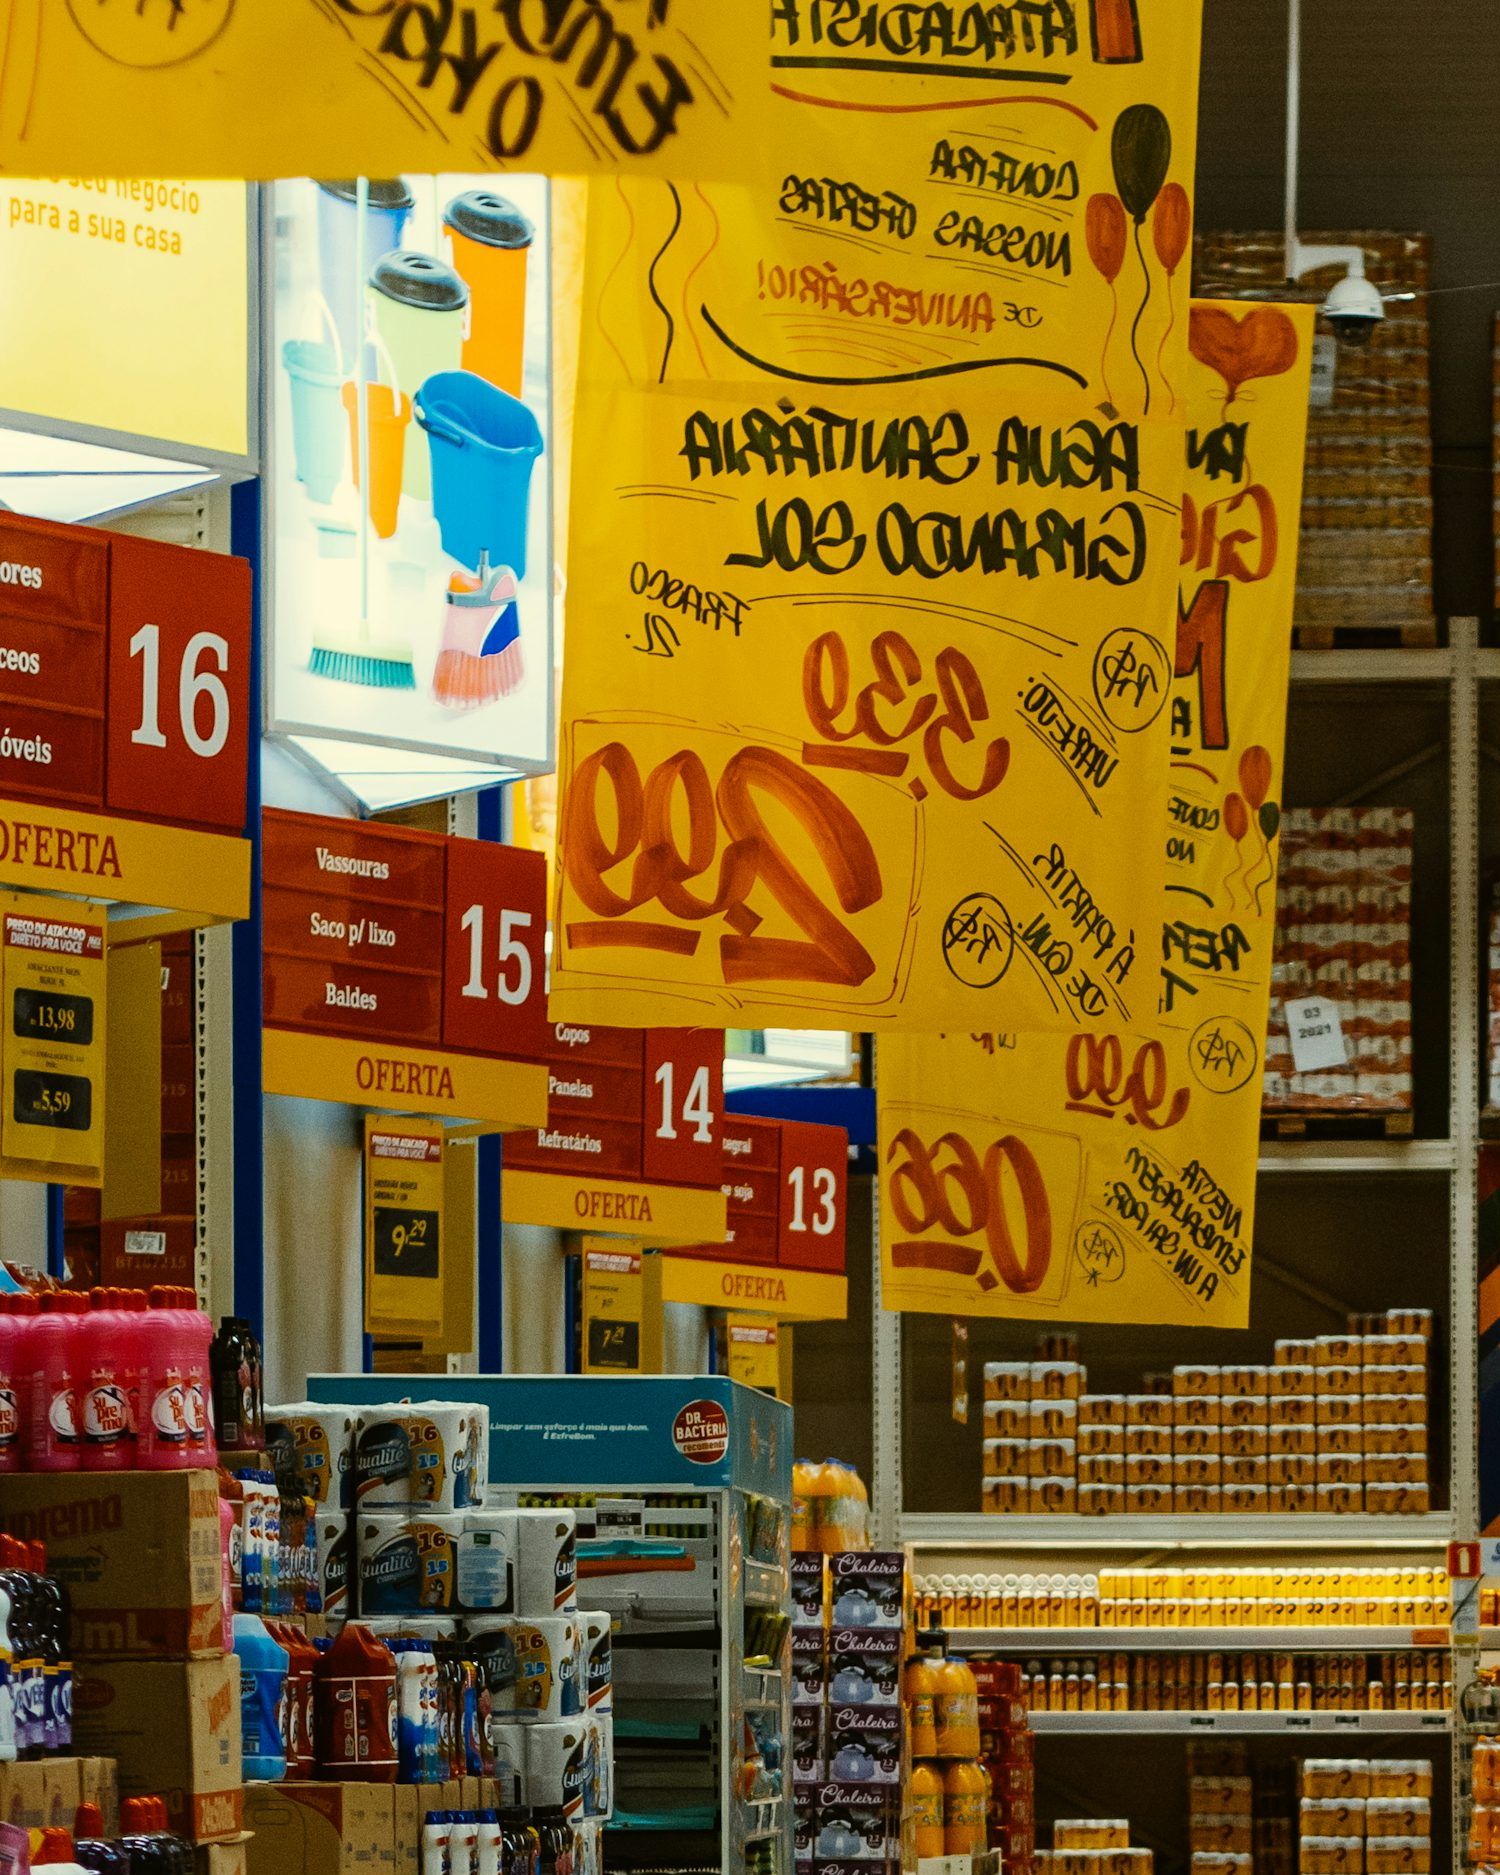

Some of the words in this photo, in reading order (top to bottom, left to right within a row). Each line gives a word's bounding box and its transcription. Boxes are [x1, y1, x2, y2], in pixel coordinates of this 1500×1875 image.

[9, 197, 60, 229] para
[68, 209, 80, 234] a
[88, 213, 126, 243] sua
[133, 223, 182, 256] casa
[129, 623, 231, 758] 16
[0, 817, 123, 879] OFERTA
[315, 847, 389, 879] Vassouras
[310, 911, 344, 938] Saco
[348, 919, 365, 947] p/
[369, 922, 396, 947] lixo
[460, 904, 532, 1006] 15
[325, 982, 377, 1011] Baldes
[37, 1006, 75, 1033] 13,98
[555, 1022, 590, 1047] Copos
[356, 1055, 455, 1100] OFERTA
[549, 1076, 593, 1098] Panelas
[655, 1061, 714, 1143] 14
[538, 1128, 602, 1153] Refratários
[574, 1189, 653, 1222] OFERTA
[734, 1183, 753, 1202] soja
[788, 1166, 837, 1235] 13
[721, 1273, 787, 1301] OFERTA
[490, 1422, 523, 1432] Limpar
[525, 1423, 542, 1431] sem
[544, 1422, 578, 1433] esforço
[585, 1423, 608, 1432] mais
[609, 1424, 626, 1433] que
[676, 1422, 728, 1440] BACTÉRIA
[685, 1411, 705, 1425] DR.
[409, 1425, 438, 1447] 16
[836, 1553, 900, 1575] Chaleira
[834, 1631, 897, 1652] Chaleira
[834, 1708, 898, 1730] Chaleira
